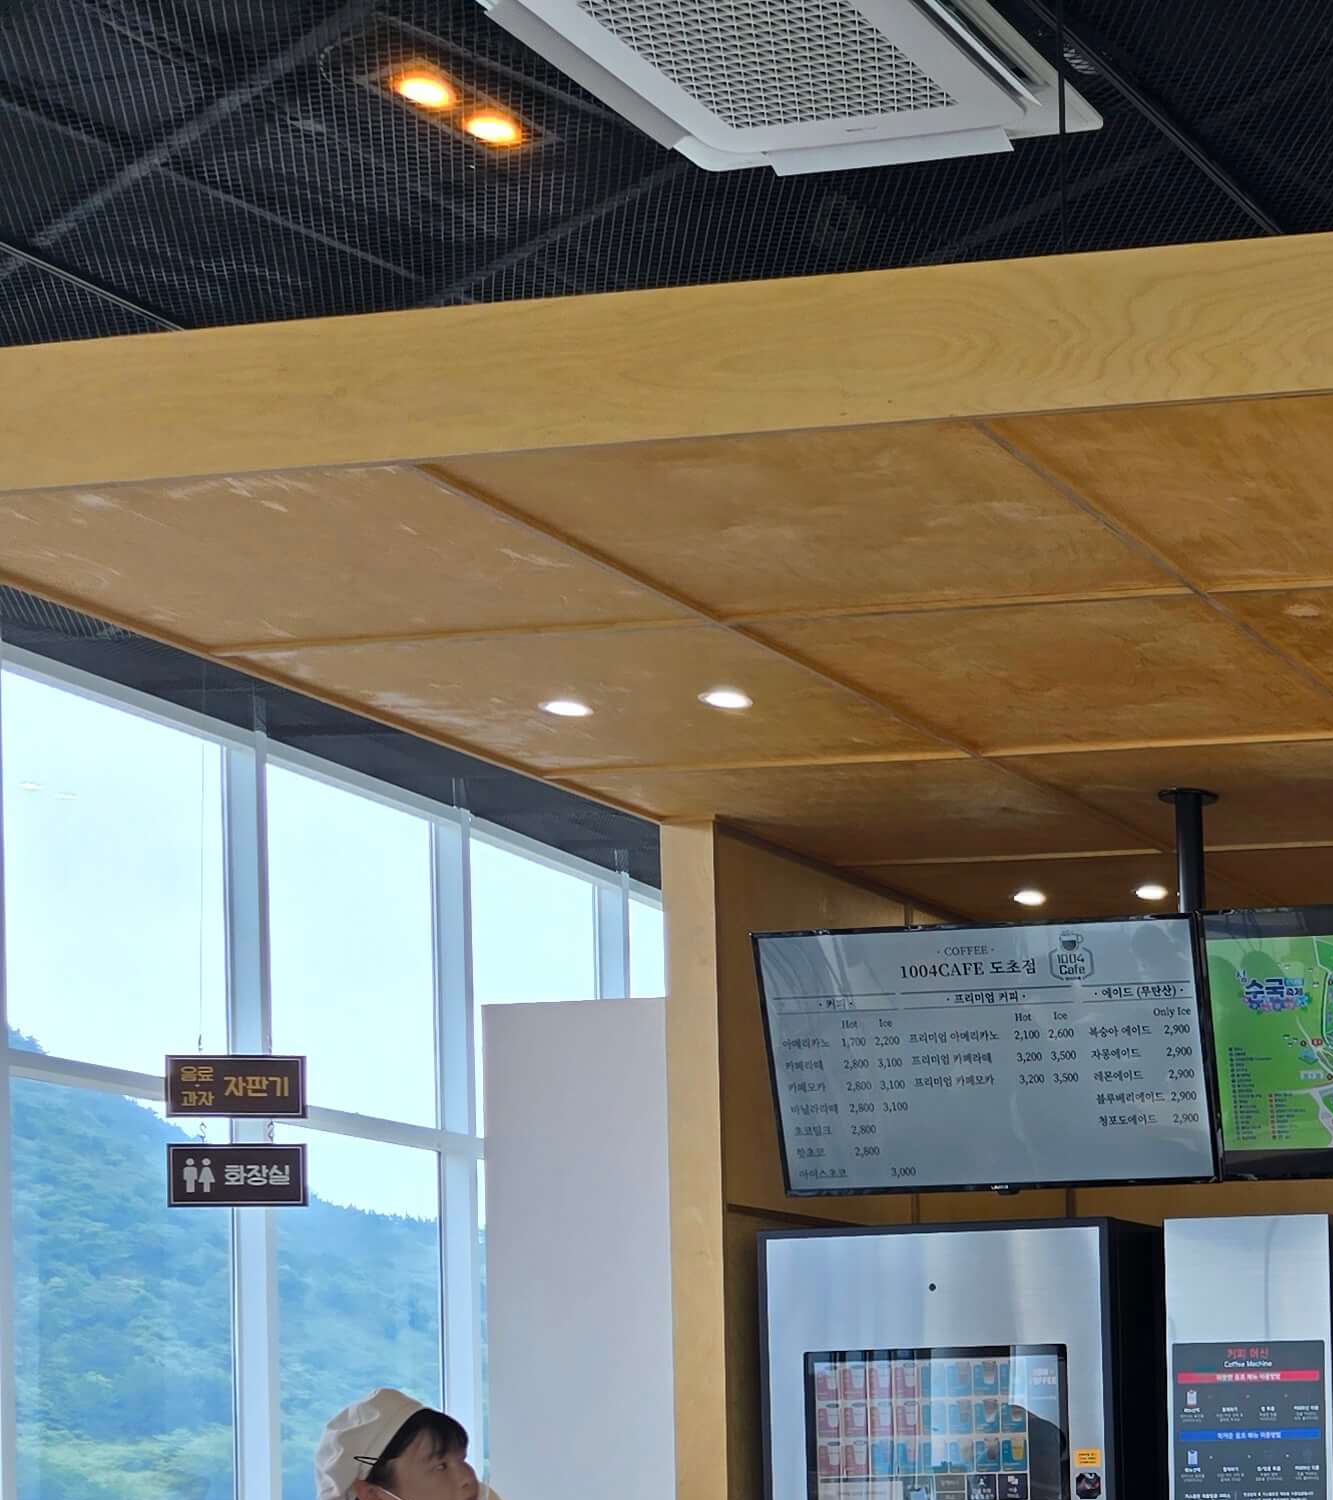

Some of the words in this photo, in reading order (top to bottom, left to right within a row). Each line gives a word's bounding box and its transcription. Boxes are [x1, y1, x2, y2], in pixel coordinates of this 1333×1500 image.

[944, 945, 988, 956] COFFEE
[1057, 954, 1084, 964] 1004
[900, 962, 984, 978] 1004CAFE
[990, 958, 1036, 974] 도초점
[1060, 964, 1085, 975] Cafe
[954, 992, 994, 1004] 프리미엄
[1000, 991, 1018, 1002] 커피
[1102, 987, 1133, 998] 에이드
[1016, 1013, 1031, 1022] Hot
[1054, 1012, 1068, 1020] Ice
[1153, 1008, 1174, 1017] Only
[1178, 1007, 1191, 1015] Ice
[1014, 1030, 1040, 1040] 2,100
[1049, 1028, 1074, 1039] 2,600
[1164, 1024, 1190, 1034] 2,900
[1017, 1052, 1042, 1063] 3,200
[1051, 1051, 1076, 1061] 3,500
[1166, 1046, 1192, 1057] 2,900
[180, 1066, 214, 1082] 음료
[1019, 1074, 1044, 1085] 3,200
[1053, 1072, 1078, 1083] 3,500
[1169, 1069, 1194, 1079] 2,900
[223, 1076, 289, 1097] 자판기
[180, 1091, 214, 1106] 과자
[1171, 1091, 1197, 1101] 2,900
[1173, 1113, 1199, 1123] 2,900
[224, 1164, 290, 1186] 화장실
